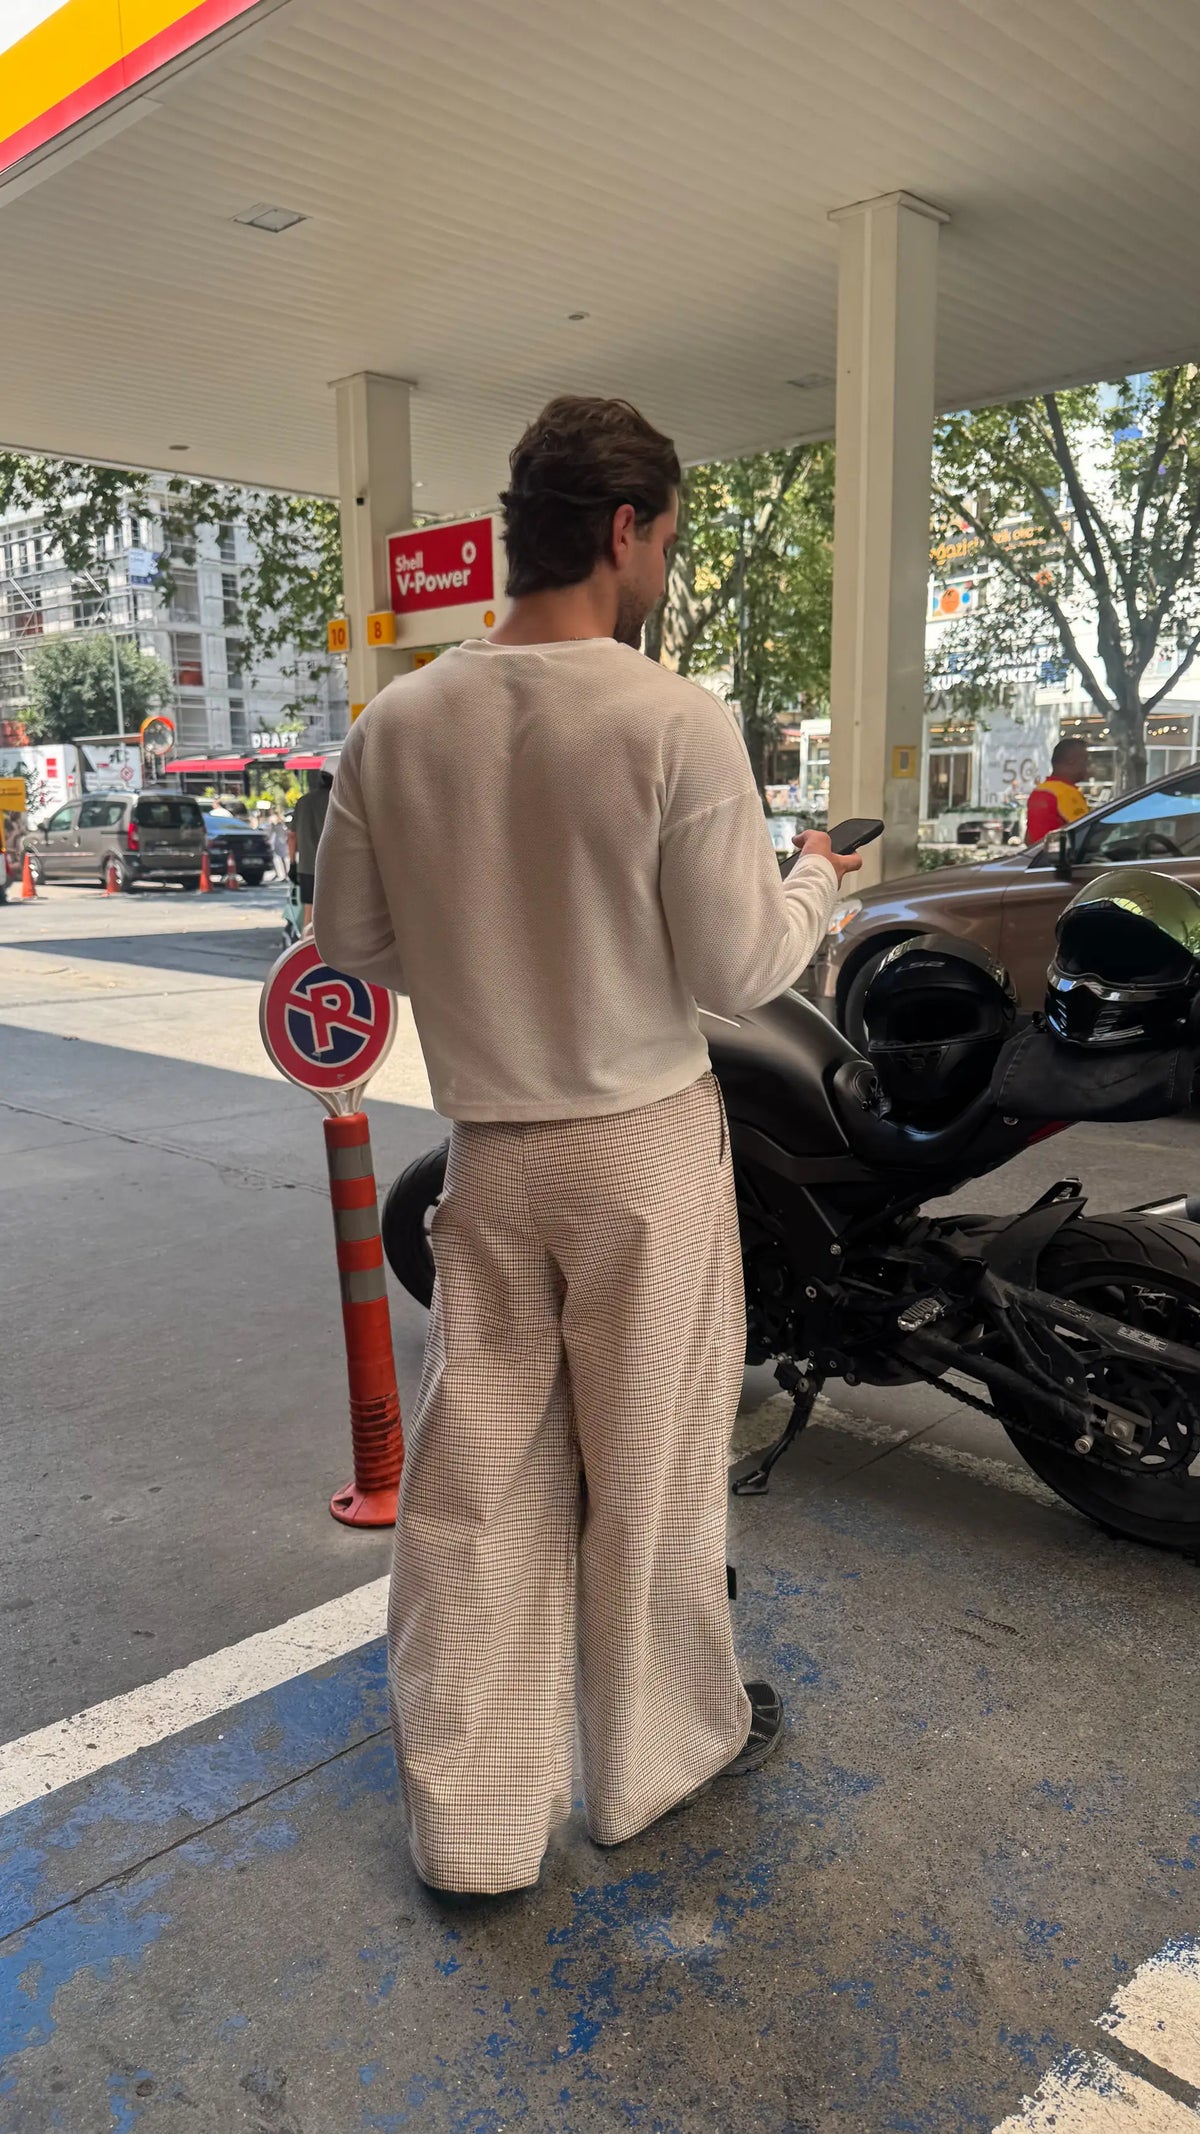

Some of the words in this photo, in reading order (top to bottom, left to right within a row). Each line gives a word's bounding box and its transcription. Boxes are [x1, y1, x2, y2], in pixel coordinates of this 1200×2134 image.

[395, 550, 424, 573] Shell
[397, 568, 471, 596] V-Power
[332, 627, 346, 646] 10
[374, 620, 383, 639] 8
[250, 731, 299, 749] DRAFT
